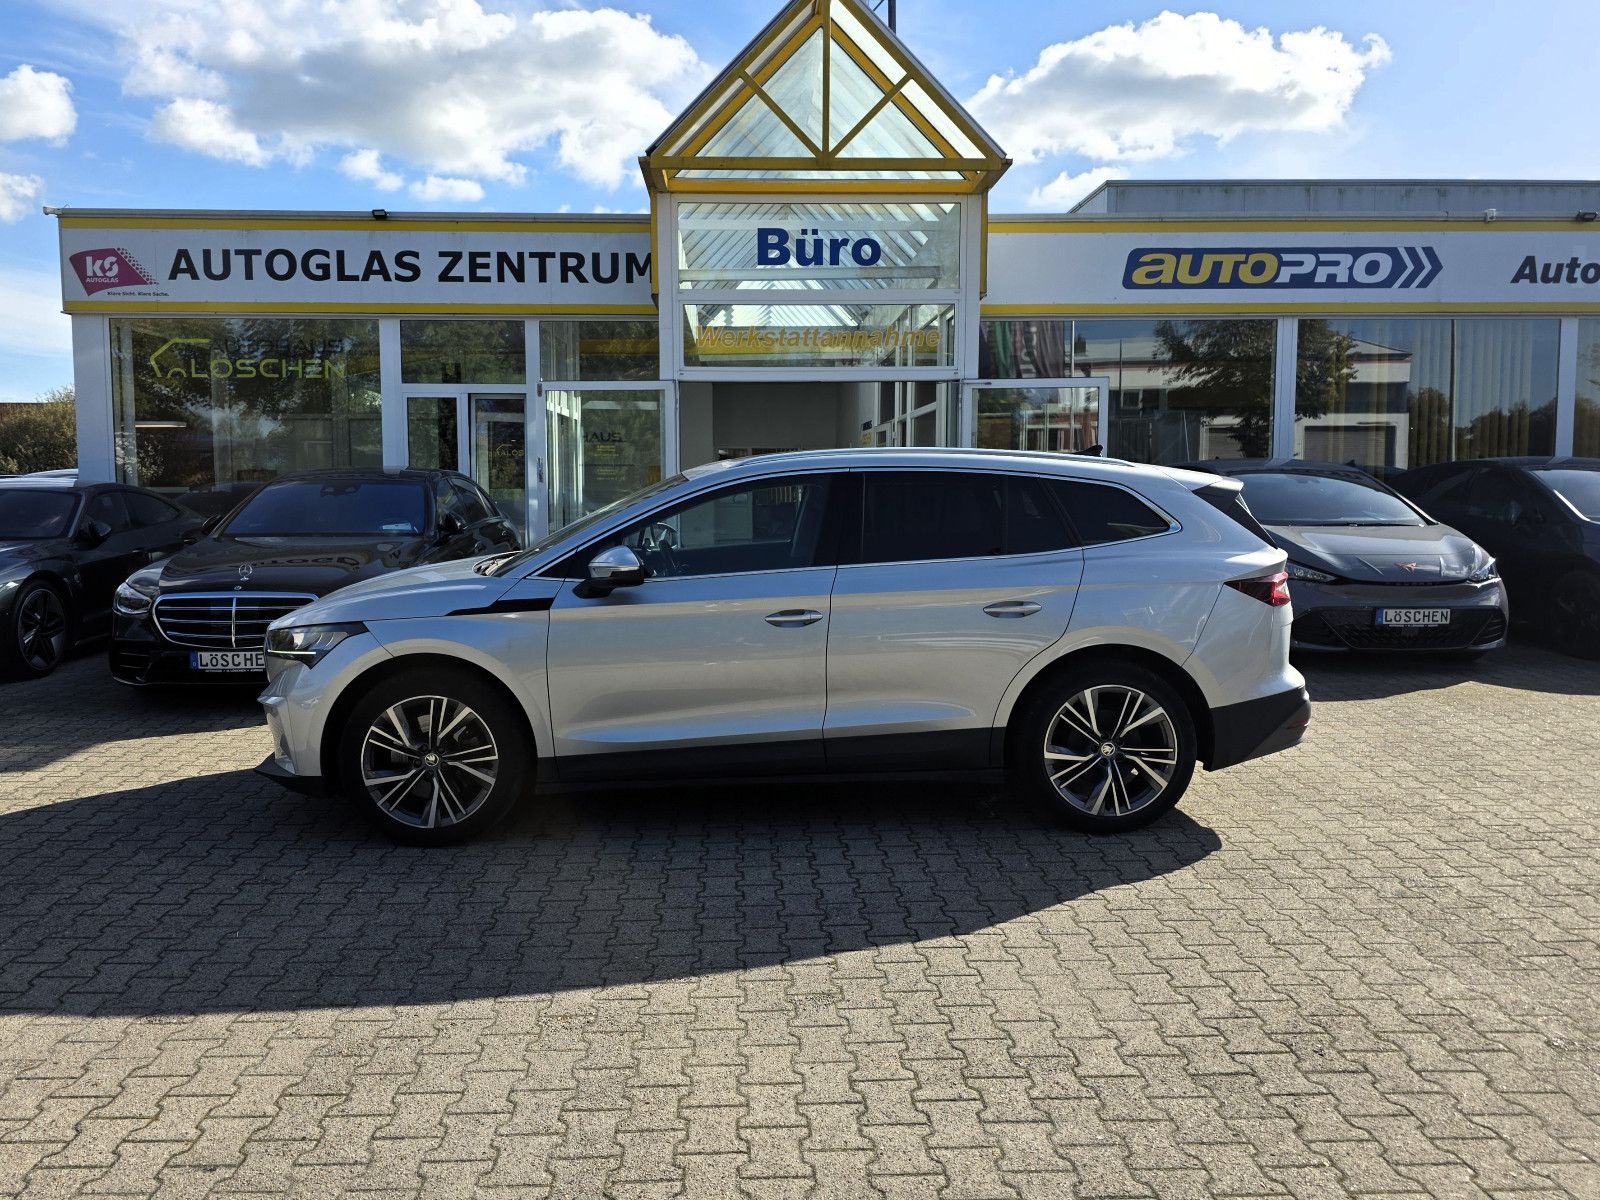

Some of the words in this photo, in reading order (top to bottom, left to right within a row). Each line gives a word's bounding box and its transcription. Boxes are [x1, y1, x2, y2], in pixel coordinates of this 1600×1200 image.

[757, 227, 881, 267] Büro
[168, 248, 420, 282] AUTOGLAS
[438, 251, 652, 284] ZENTRUM
[1510, 255, 1600, 284] Auto
[697, 325, 941, 348] Werkstattannahme
[199, 653, 265, 667] LÖSCHE
